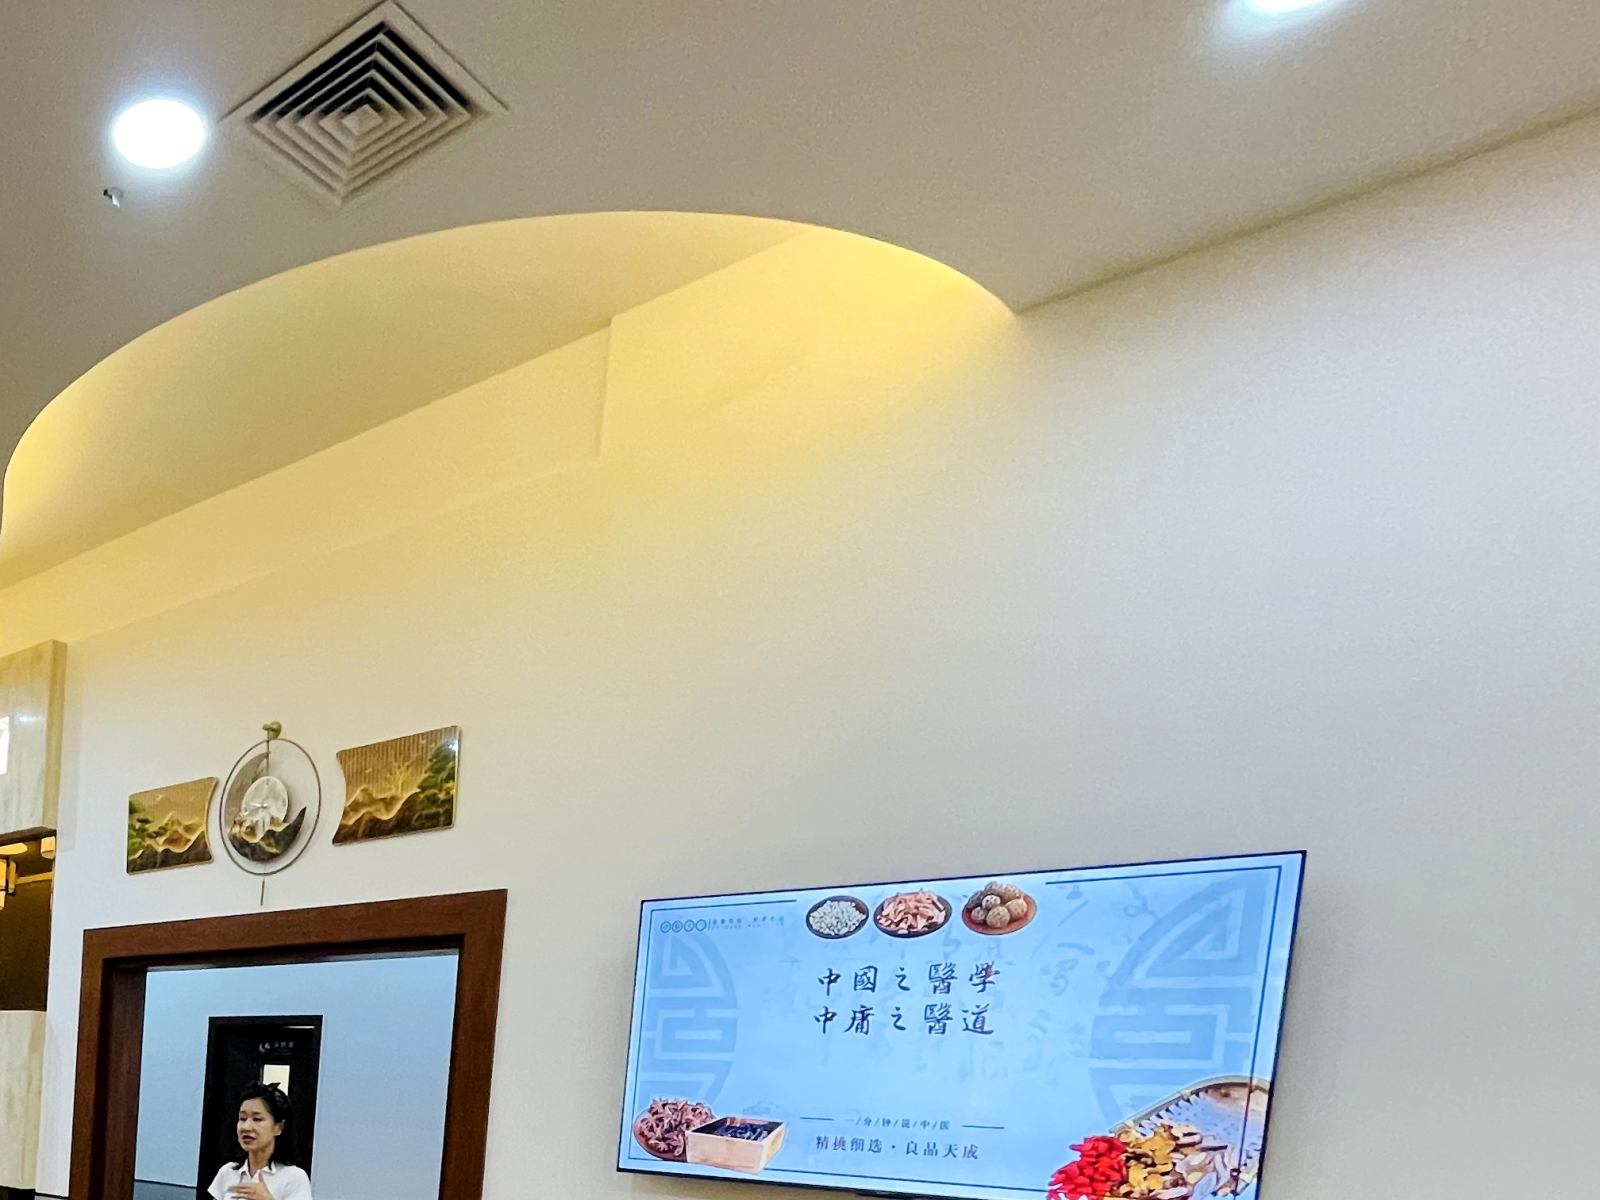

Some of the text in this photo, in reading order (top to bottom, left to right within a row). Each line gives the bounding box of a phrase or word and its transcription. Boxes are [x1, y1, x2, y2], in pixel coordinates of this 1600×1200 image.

[813, 1003, 995, 1035] 中庸之醫道
